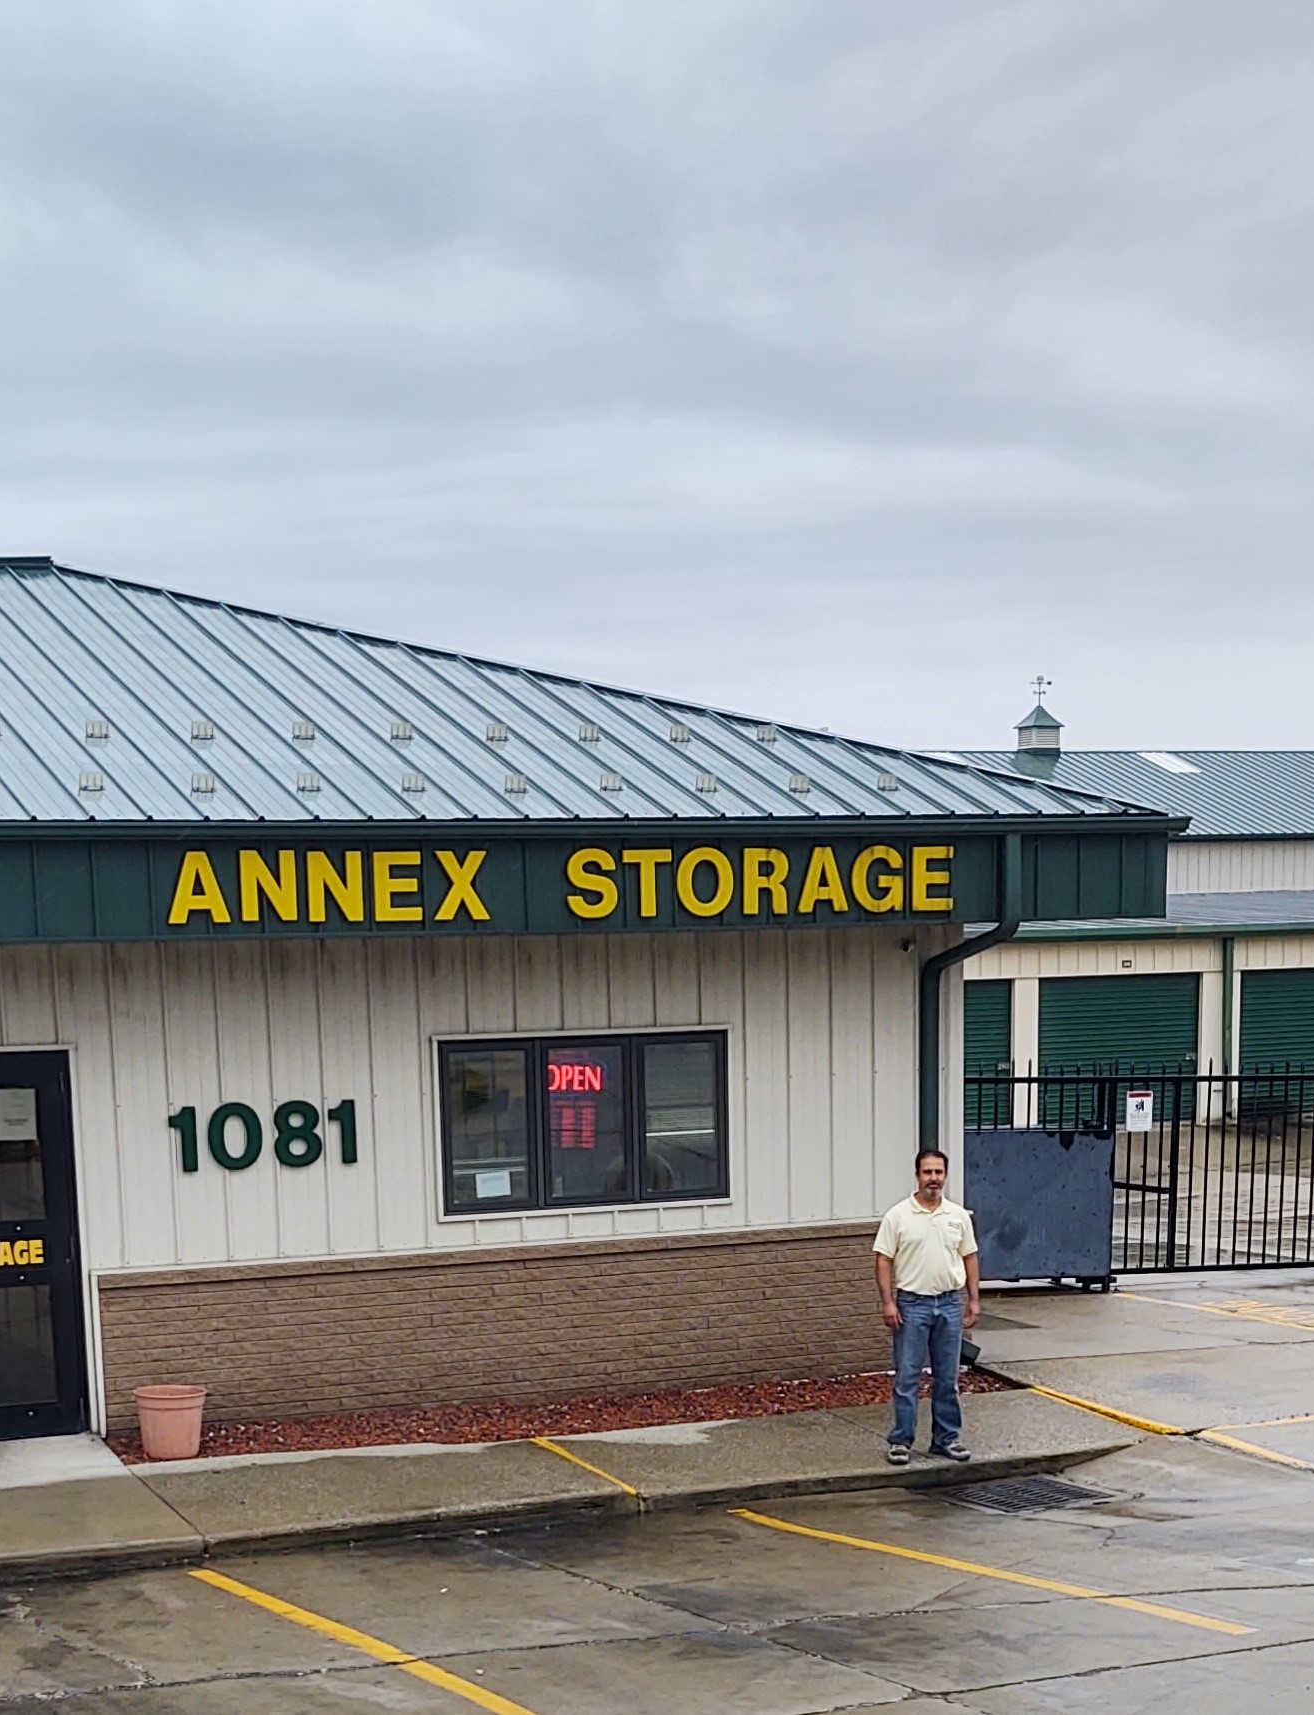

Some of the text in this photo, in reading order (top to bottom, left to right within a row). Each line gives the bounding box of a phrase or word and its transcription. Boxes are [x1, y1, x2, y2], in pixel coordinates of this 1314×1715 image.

[168, 845, 953, 924] ANNEX STORAGE
[547, 1064, 602, 1091] OPEN
[167, 1099, 358, 1173] 1081
